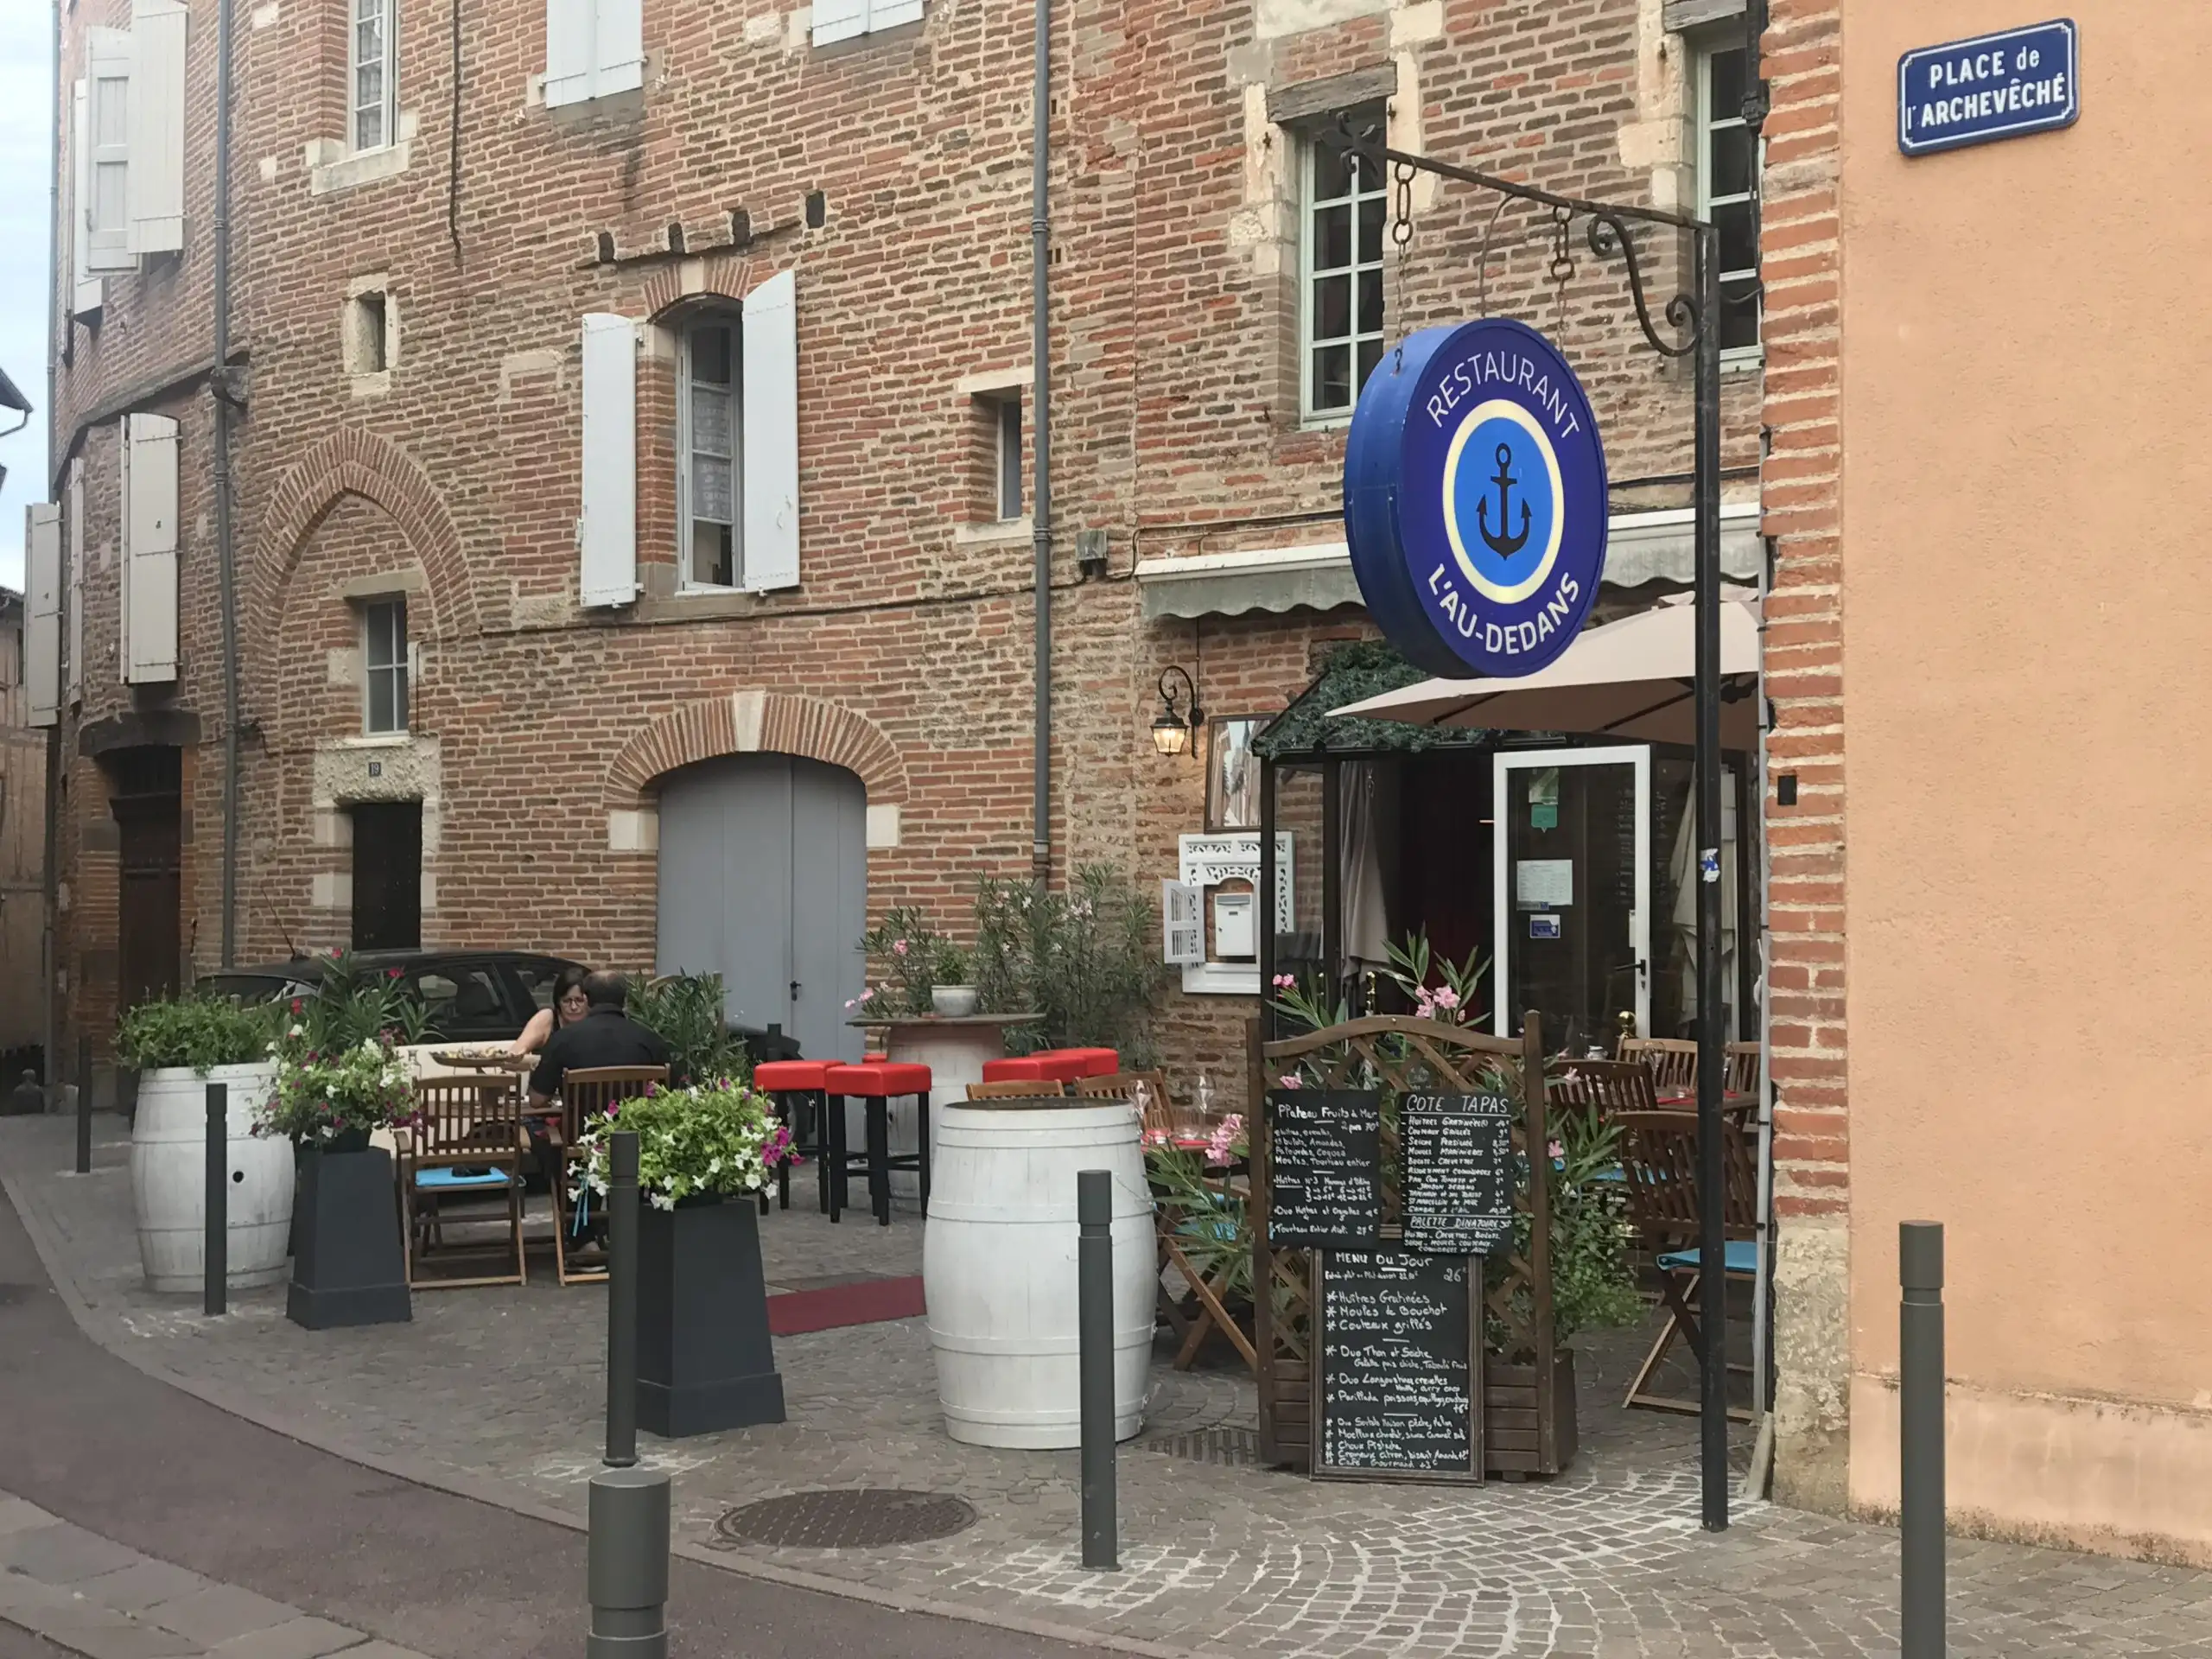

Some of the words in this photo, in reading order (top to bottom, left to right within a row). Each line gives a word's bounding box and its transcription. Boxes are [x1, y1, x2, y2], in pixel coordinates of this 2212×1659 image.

[1930, 51, 2005, 89] PLACE
[2017, 46, 2039, 70] de
[1908, 73, 2065, 130] l'ARCHEVÊCHÉ
[1427, 351, 1580, 439] RESTAURANT
[1427, 563, 1580, 655] L'AU-DEDANS
[1462, 1095, 1509, 1113] TAPAS
[1321, 1106, 1349, 1118] Fruits
[1360, 1108, 1377, 1118] Mer
[1346, 1158, 1370, 1167] entier
[1410, 1216, 1447, 1228] PALETTE
[1335, 1252, 1368, 1264] MENU
[1398, 1254, 1433, 1267] Jour
[1340, 1305, 1379, 1317] Moules
[1399, 1302, 1447, 1316] Bouchot
[1339, 1319, 1389, 1331] Couteaux
[1393, 1317, 1433, 1334] grillés
[1340, 1344, 1361, 1357] Duo
[1363, 1344, 1386, 1357] Thon
[1339, 1372, 1359, 1384] Duo
